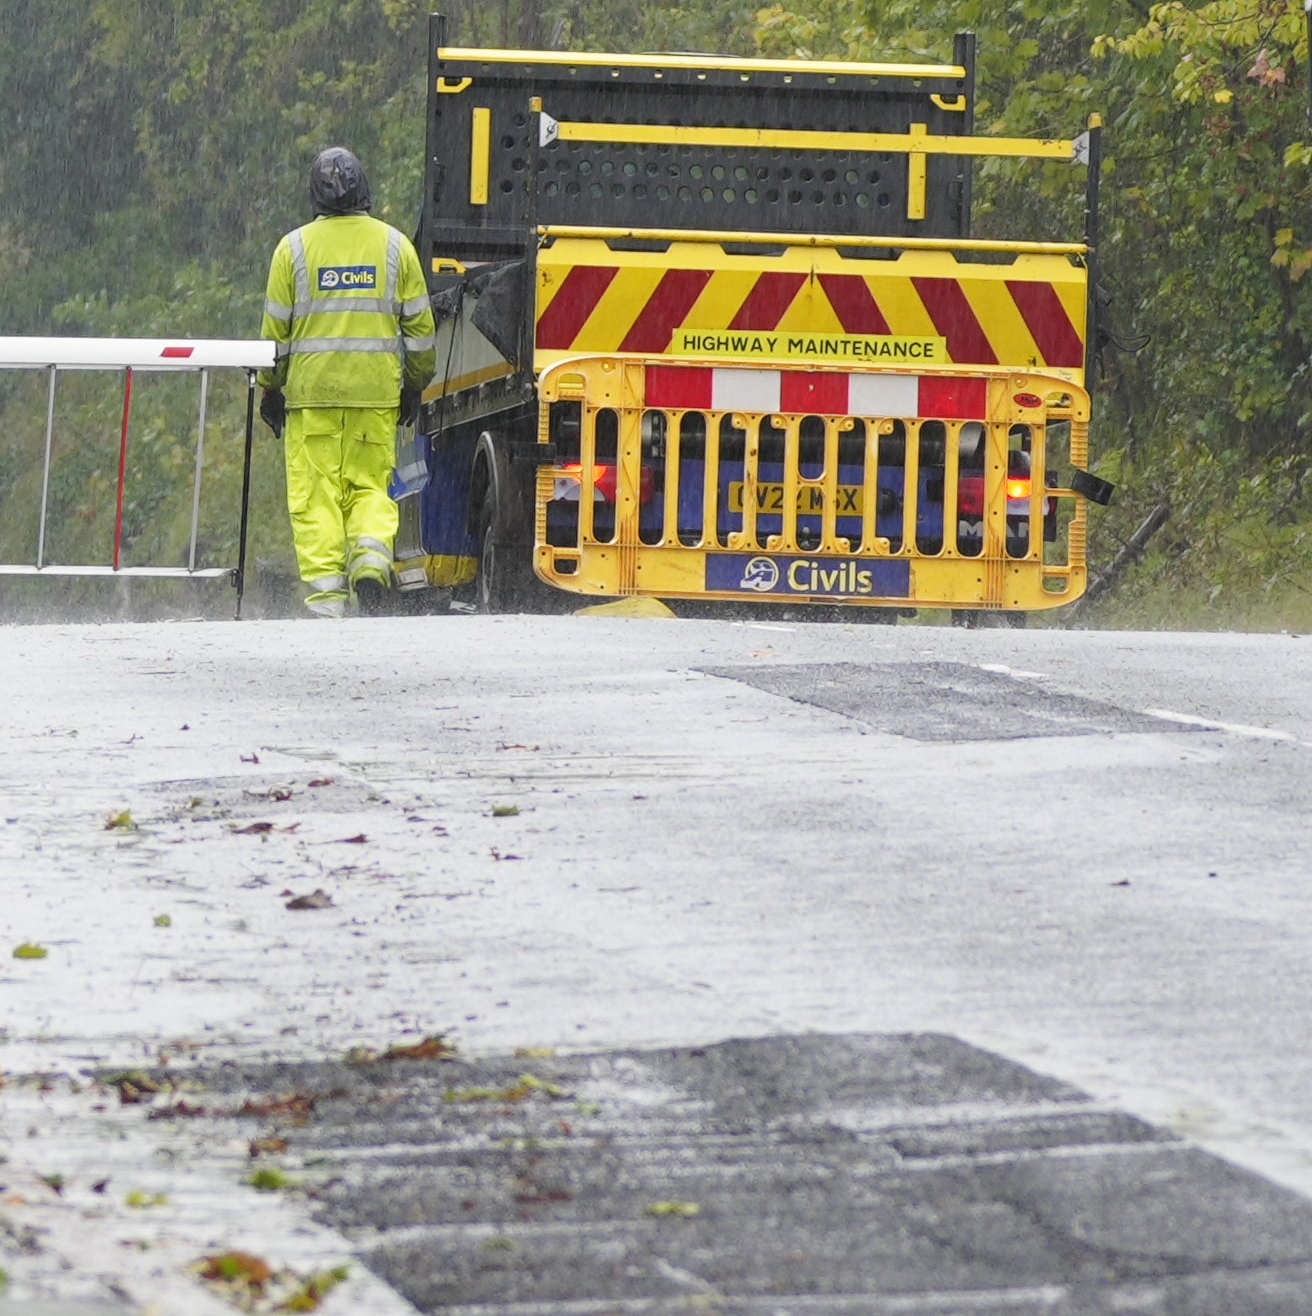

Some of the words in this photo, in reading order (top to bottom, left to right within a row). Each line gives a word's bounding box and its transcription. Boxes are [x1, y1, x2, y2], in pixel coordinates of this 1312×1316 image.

[341, 270, 375, 284] Civils
[683, 335, 778, 353] HIGHWAY
[788, 338, 934, 358] MAINTENANCE
[787, 559, 873, 593] Civils
